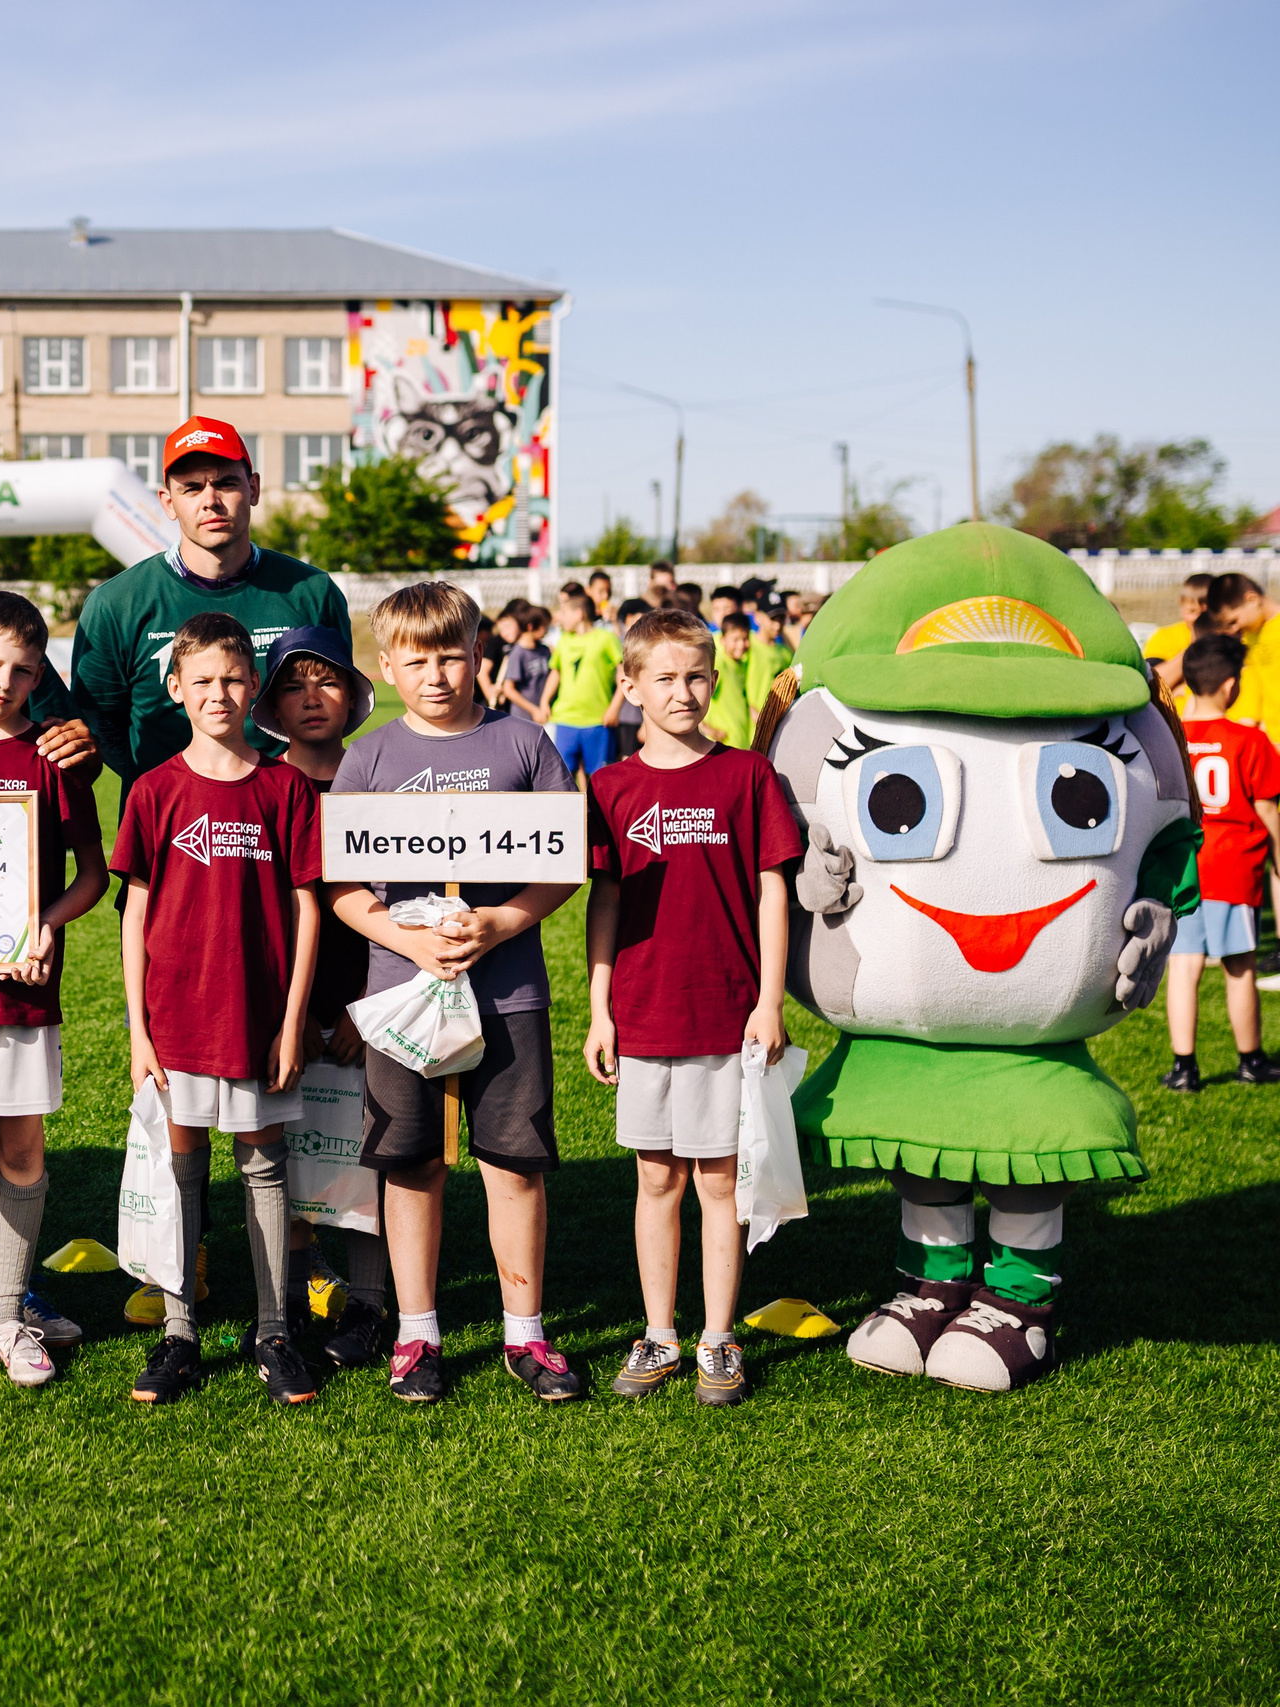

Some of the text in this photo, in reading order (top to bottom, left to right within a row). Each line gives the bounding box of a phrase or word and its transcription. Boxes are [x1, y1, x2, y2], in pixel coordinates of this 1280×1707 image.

[436, 768, 490, 784] РУССКАЯ
[661, 808, 715, 820] РУССКАЯ
[211, 822, 262, 835] РУССКАЯ
[662, 820, 713, 833] МЕДНАЯ
[212, 834, 258, 847] МЕДНАЯ
[345, 830, 565, 860] Метеор 14-15
[663, 832, 728, 845] КОМПАНИЯ
[212, 846, 273, 862] КОМПАНИЯ
[319, 1088, 360, 1098] ФУТБОЛОМ
